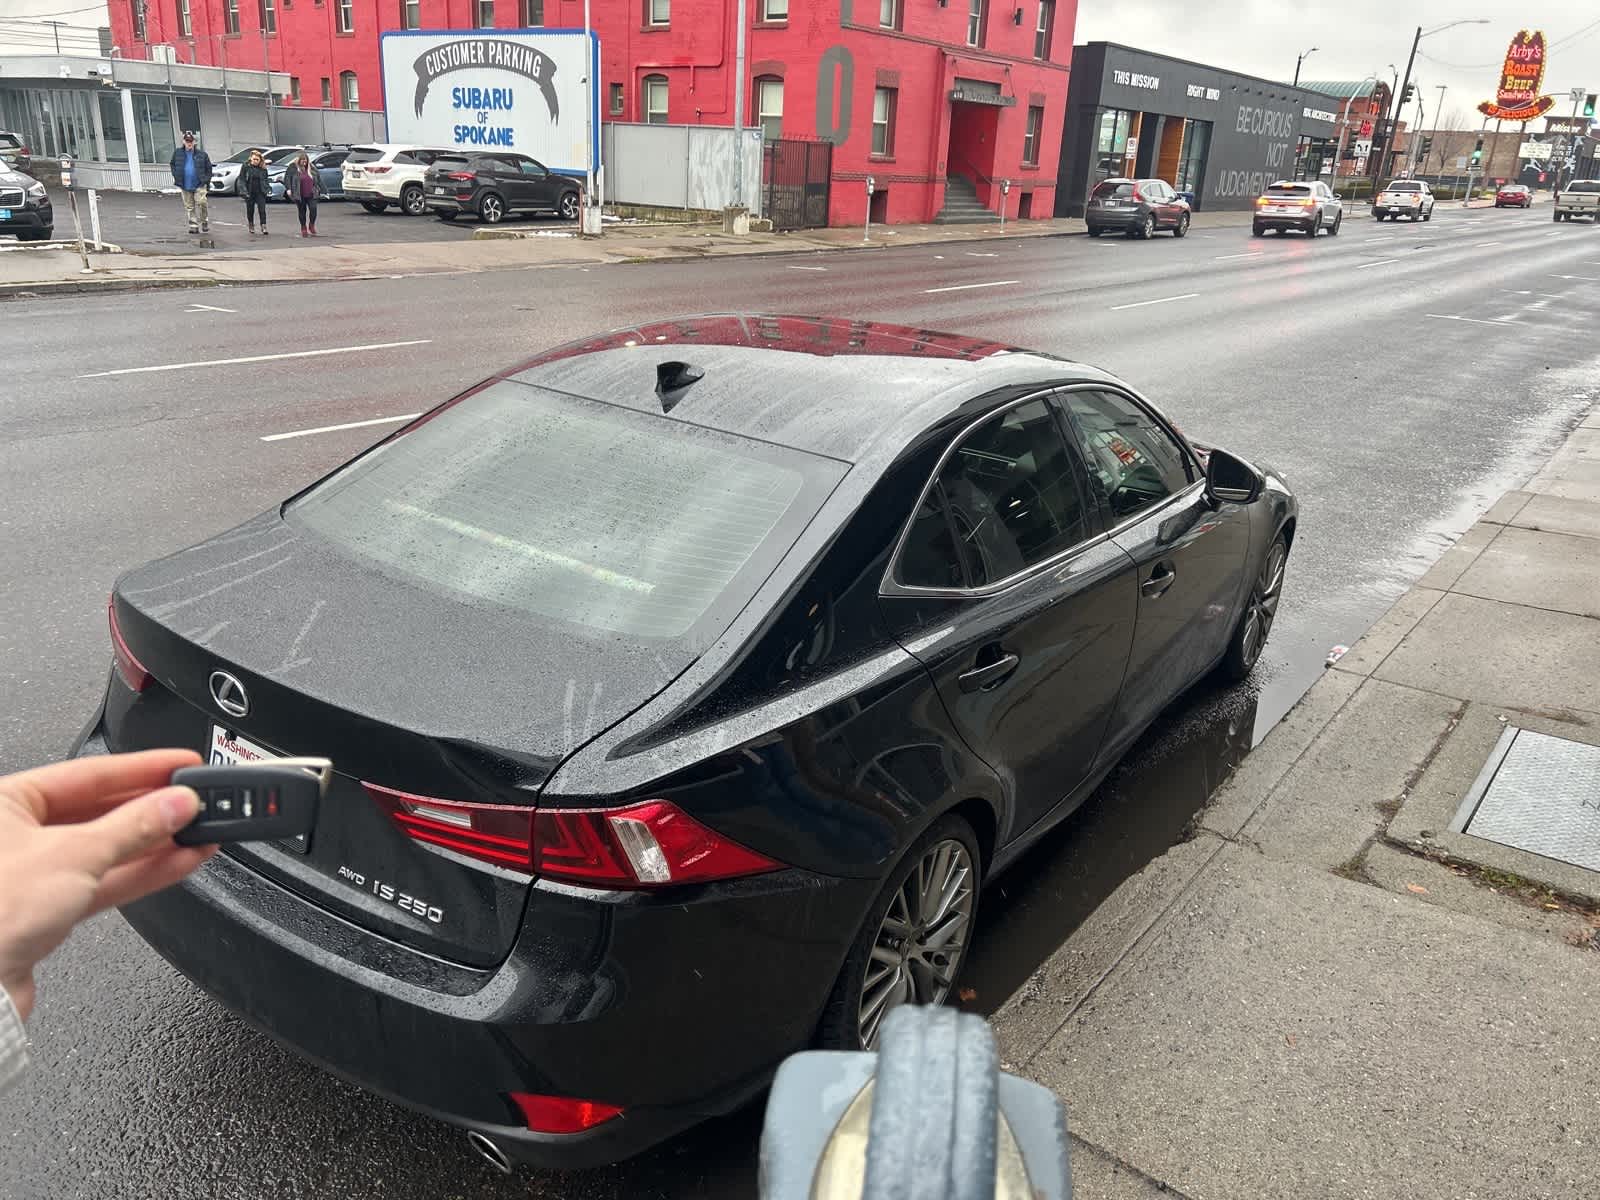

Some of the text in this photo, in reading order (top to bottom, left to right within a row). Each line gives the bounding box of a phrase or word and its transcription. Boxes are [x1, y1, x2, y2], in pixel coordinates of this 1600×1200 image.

[425, 41, 541, 77] CUSTOMER PARKING
[1508, 44, 1542, 61] Arby's
[1504, 60, 1540, 76] ROAST
[1113, 70, 1160, 90] THIS MISSION
[1505, 75, 1534, 90] BEEF
[452, 87, 513, 110] SUBARU
[1186, 84, 1220, 101] RIGHT MIND
[1498, 90, 1535, 100] Sandwich
[477, 111, 489, 124] OF
[1236, 105, 1293, 138] BE CURIOUS
[454, 124, 514, 146] SPOKANE
[1265, 142, 1288, 167] NOT
[1215, 169, 1280, 197] JUDGMENT
[217, 734, 264, 760] WASHING
[338, 865, 443, 923] AWD IS 250
